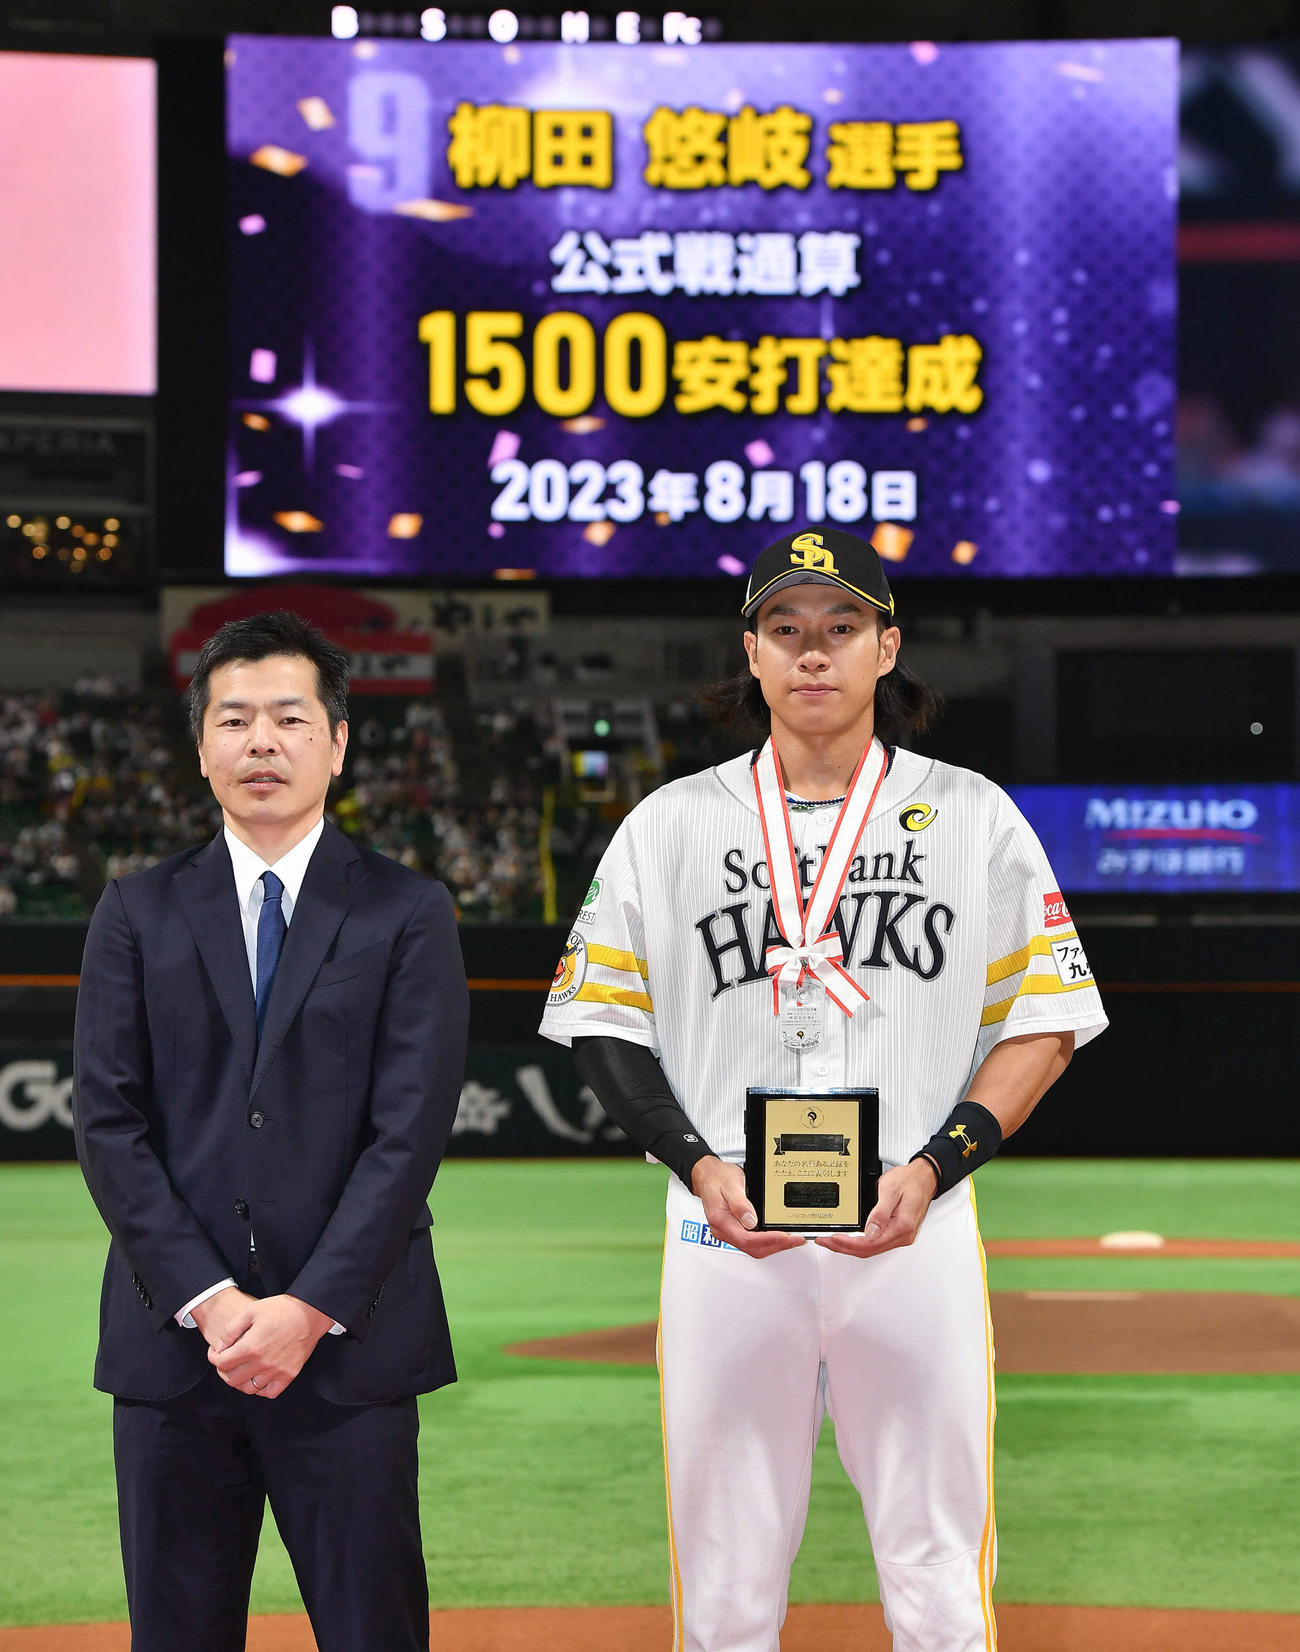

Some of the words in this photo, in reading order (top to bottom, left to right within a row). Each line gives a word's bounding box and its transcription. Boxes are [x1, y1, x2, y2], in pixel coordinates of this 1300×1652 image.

[420, 7, 447, 42] S
[347, 72, 430, 213] 9
[448, 102, 613, 189] 柳田
[644, 106, 812, 190] 悠岐
[827, 120, 963, 190] 選手
[550, 231, 862, 297] 公式戦通算
[418, 311, 984, 417] 1500安打達成
[490, 459, 918, 522] 2023年8月18日
[550, 985, 577, 1002] HAWKS
